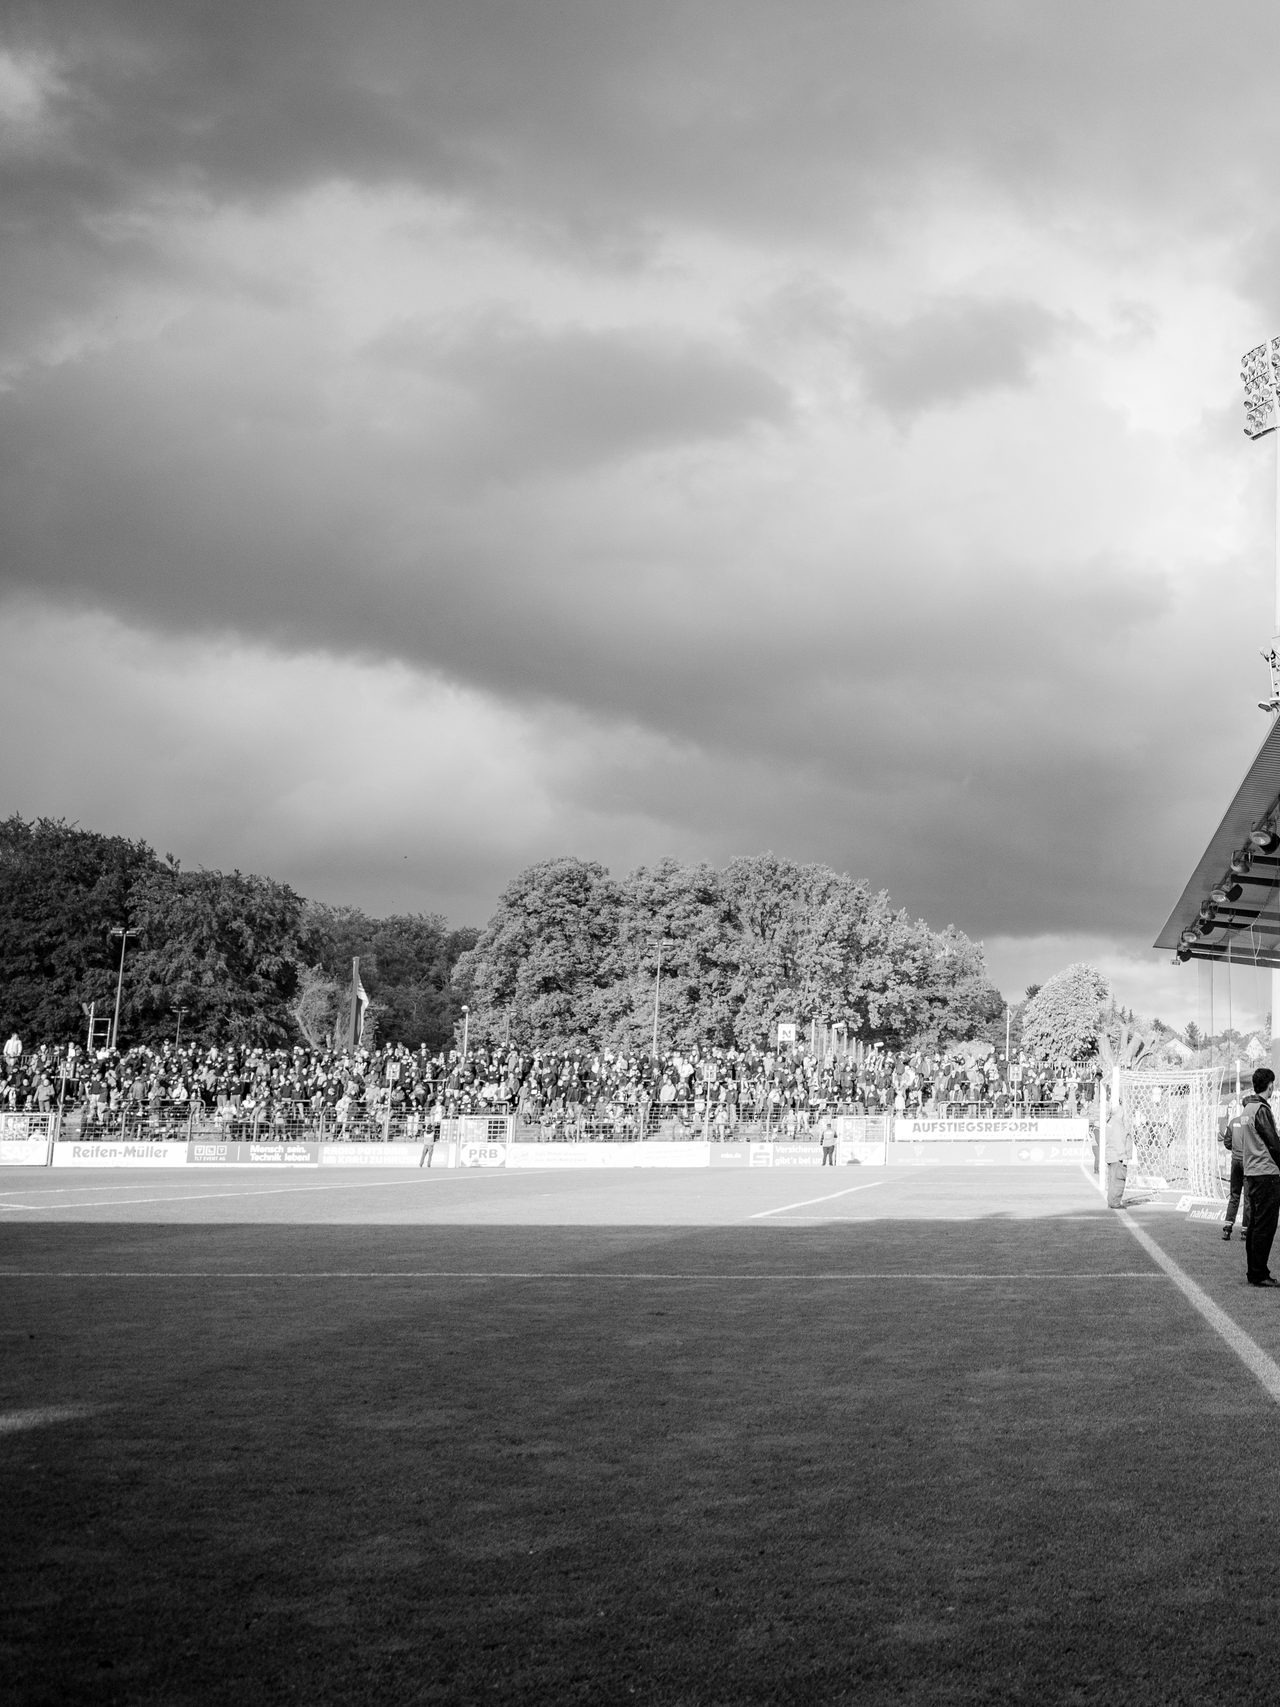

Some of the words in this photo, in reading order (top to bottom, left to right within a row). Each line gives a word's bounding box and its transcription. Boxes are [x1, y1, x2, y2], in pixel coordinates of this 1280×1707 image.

[912, 1121, 1039, 1133] AUFSTIEGSREFORM
[72, 1146, 168, 1158] Reifen-Müller
[469, 1149, 498, 1158] PRB
[1189, 1207, 1222, 1220] nahkauf
